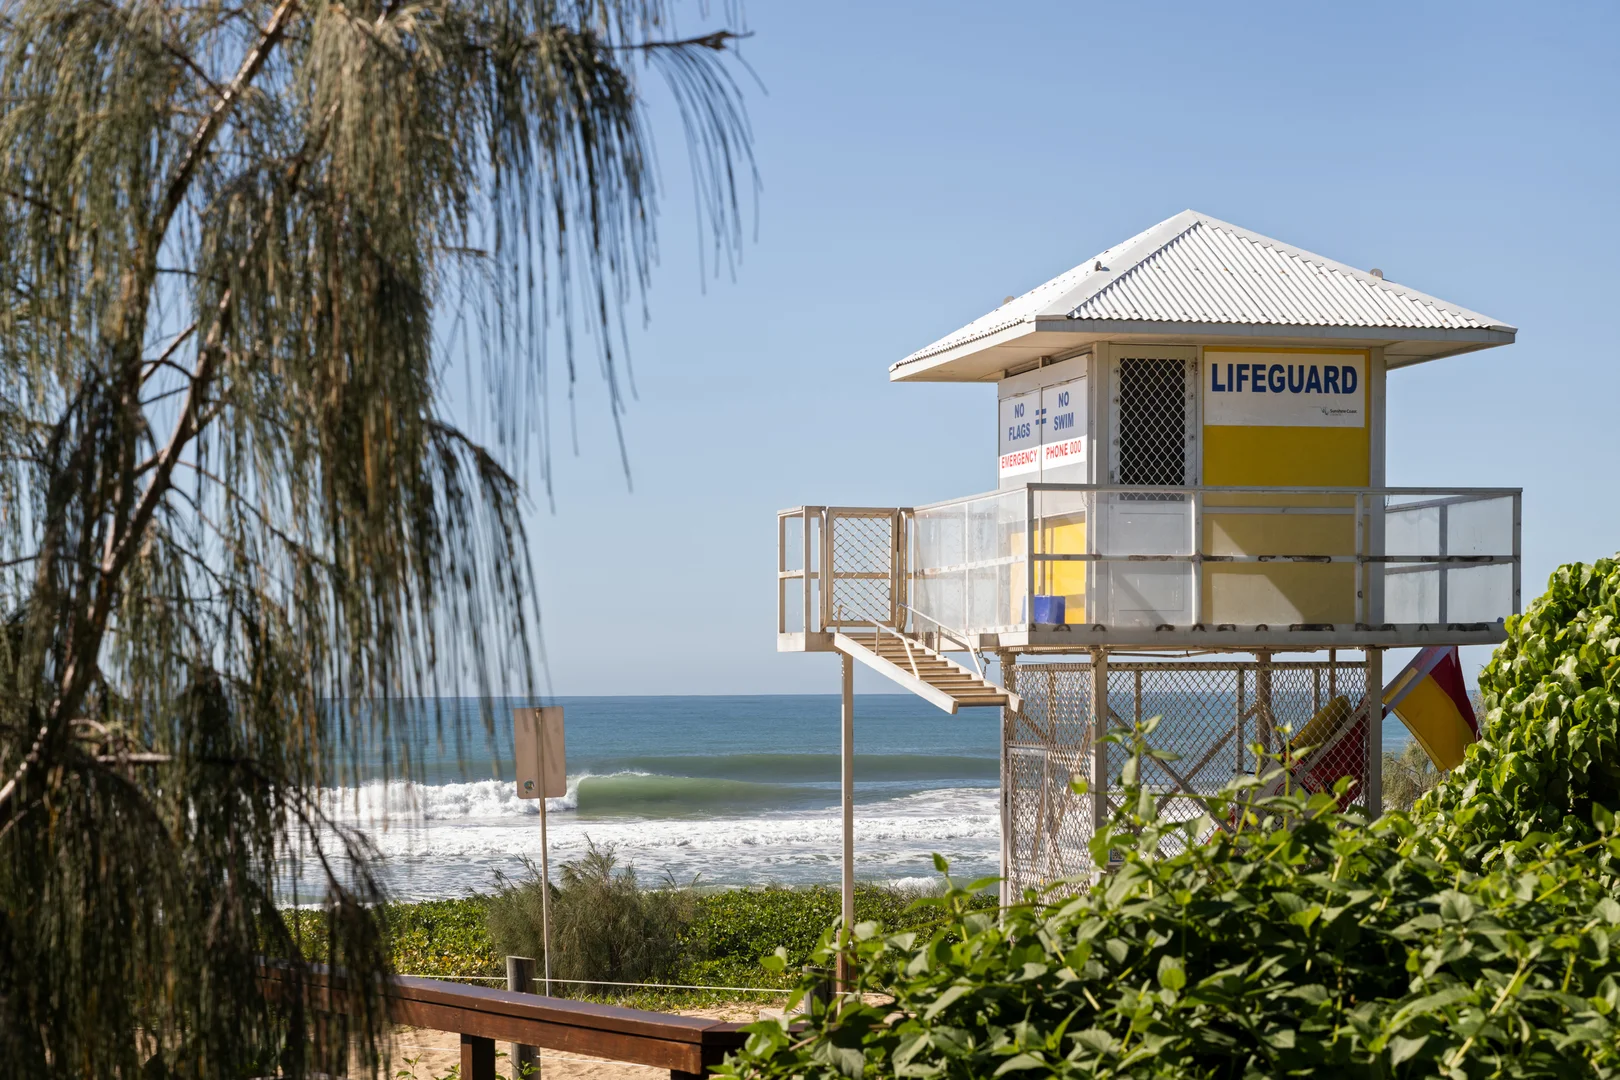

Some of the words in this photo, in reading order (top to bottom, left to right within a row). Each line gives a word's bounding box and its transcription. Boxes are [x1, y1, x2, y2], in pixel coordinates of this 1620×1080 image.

[1212, 363, 1357, 394] LIFEGUARD
[1058, 391, 1069, 408] NO
[1014, 403, 1025, 418] NO
[1053, 412, 1074, 431] SWIM
[1008, 423, 1031, 441] FLAGS
[1001, 449, 1038, 469] EMERGENCY
[1045, 443, 1068, 460] PHONE
[1070, 440, 1081, 454] 000
